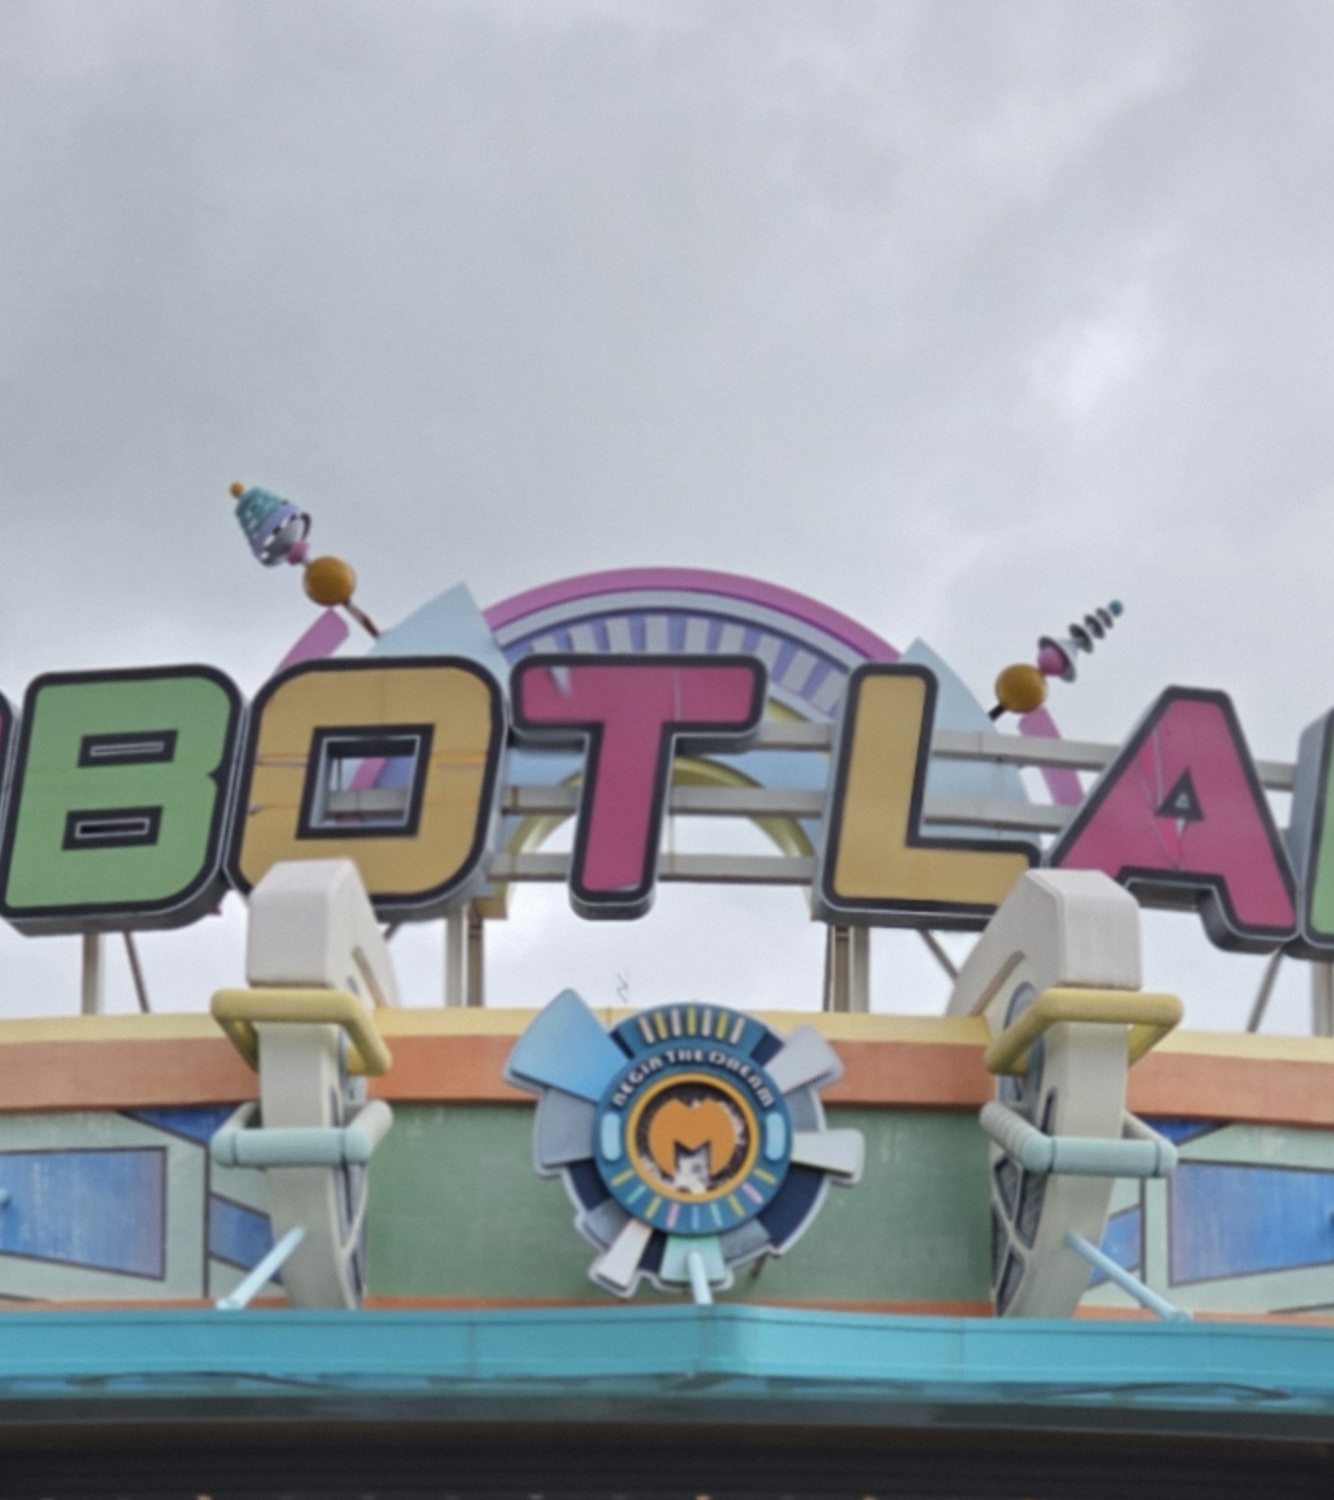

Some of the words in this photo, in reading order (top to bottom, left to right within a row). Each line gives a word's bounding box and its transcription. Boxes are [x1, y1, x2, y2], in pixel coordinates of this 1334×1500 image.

[612, 1056, 663, 1107] BEGIN
[666, 1050, 705, 1063] THE
[708, 1050, 775, 1107] DREAM
